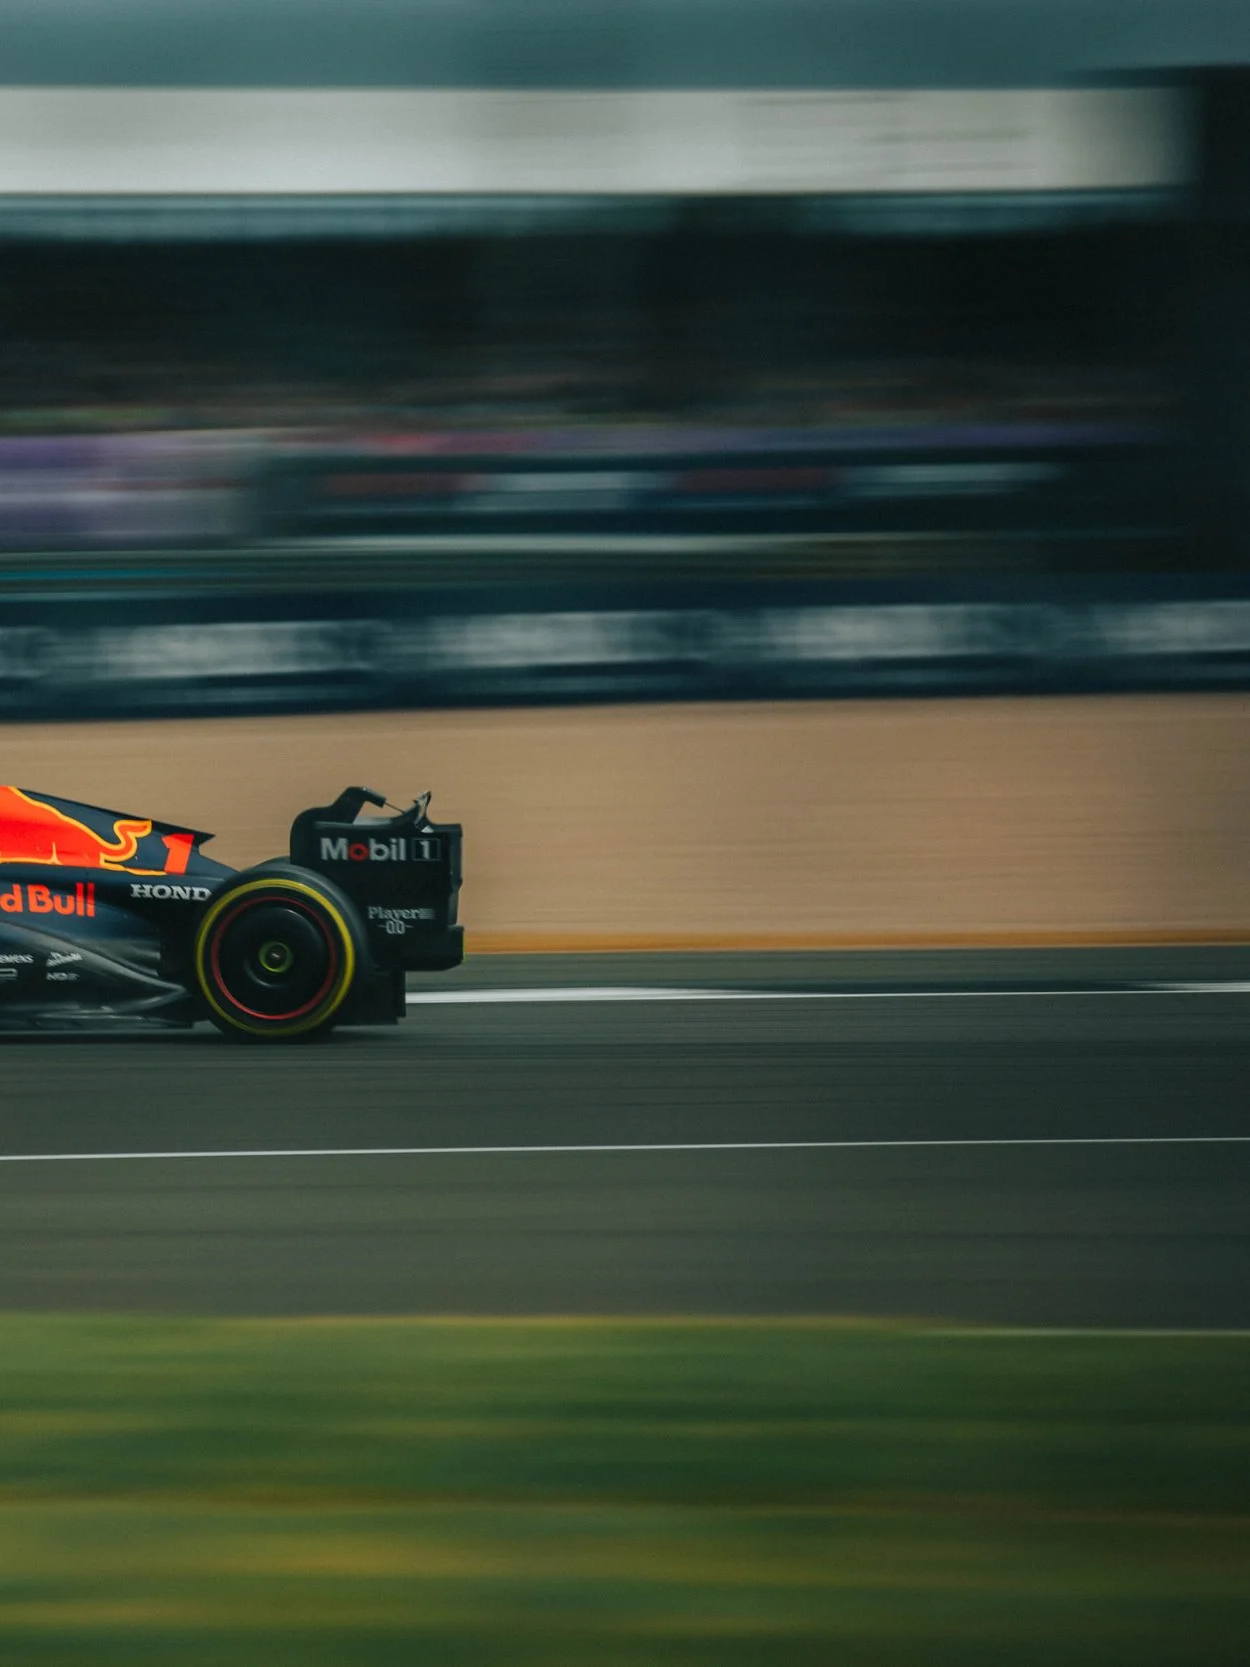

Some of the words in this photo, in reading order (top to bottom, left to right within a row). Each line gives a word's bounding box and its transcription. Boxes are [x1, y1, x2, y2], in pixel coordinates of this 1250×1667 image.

[161, 833, 195, 875] 1
[320, 837, 407, 861] Mobil
[419, 840, 431, 860] 1
[27, 882, 95, 918] Bull
[130, 883, 213, 901] HOND
